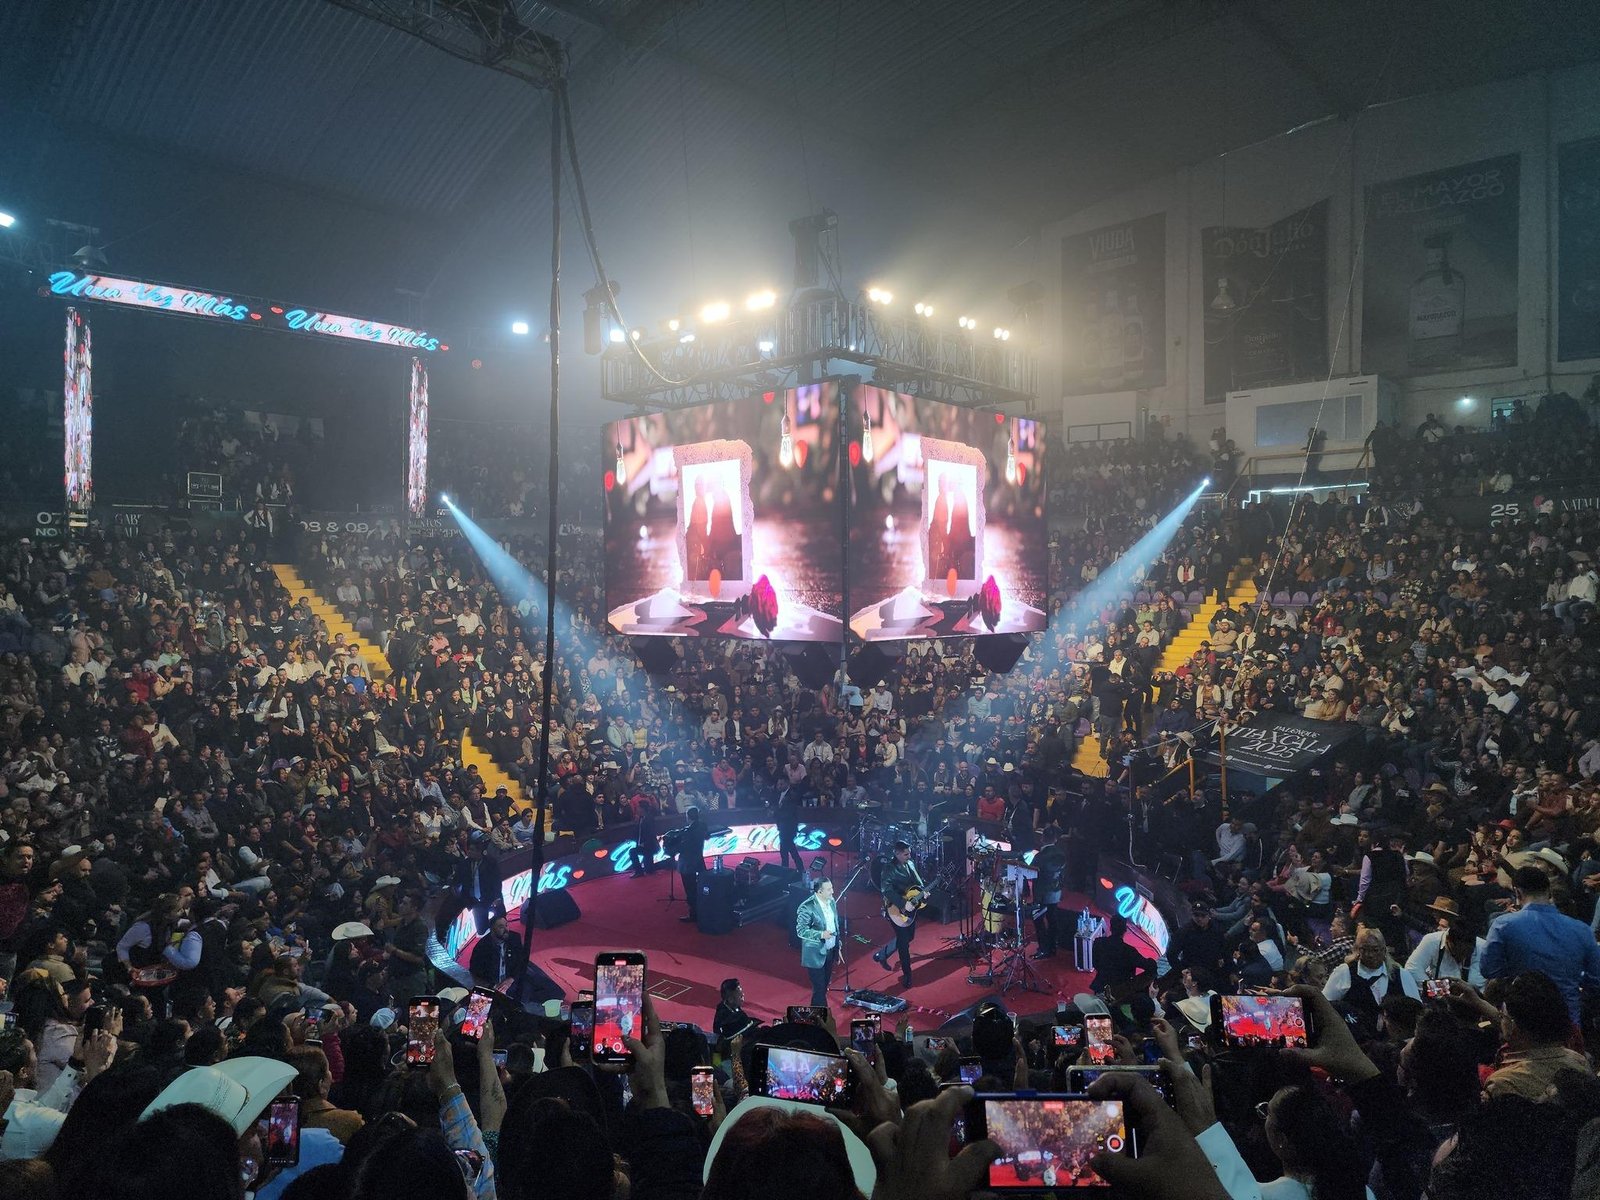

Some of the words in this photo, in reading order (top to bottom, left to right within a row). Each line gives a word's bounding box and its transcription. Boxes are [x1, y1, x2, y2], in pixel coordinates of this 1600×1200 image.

[1413, 168, 1501, 198] MAYOR
[1088, 225, 1136, 260] VIUDA
[48, 271, 121, 299] Una
[131, 284, 174, 309] Vez
[182, 291, 248, 320] Más
[285, 309, 343, 332] Una
[349, 318, 382, 340] Vez
[388, 326, 439, 350] Más
[1490, 503, 1520, 517] 25
[326, 521, 340, 533] &
[345, 522, 369, 534] 09
[1229, 727, 1332, 756] TLAXCALA
[1240, 739, 1294, 759] 2025
